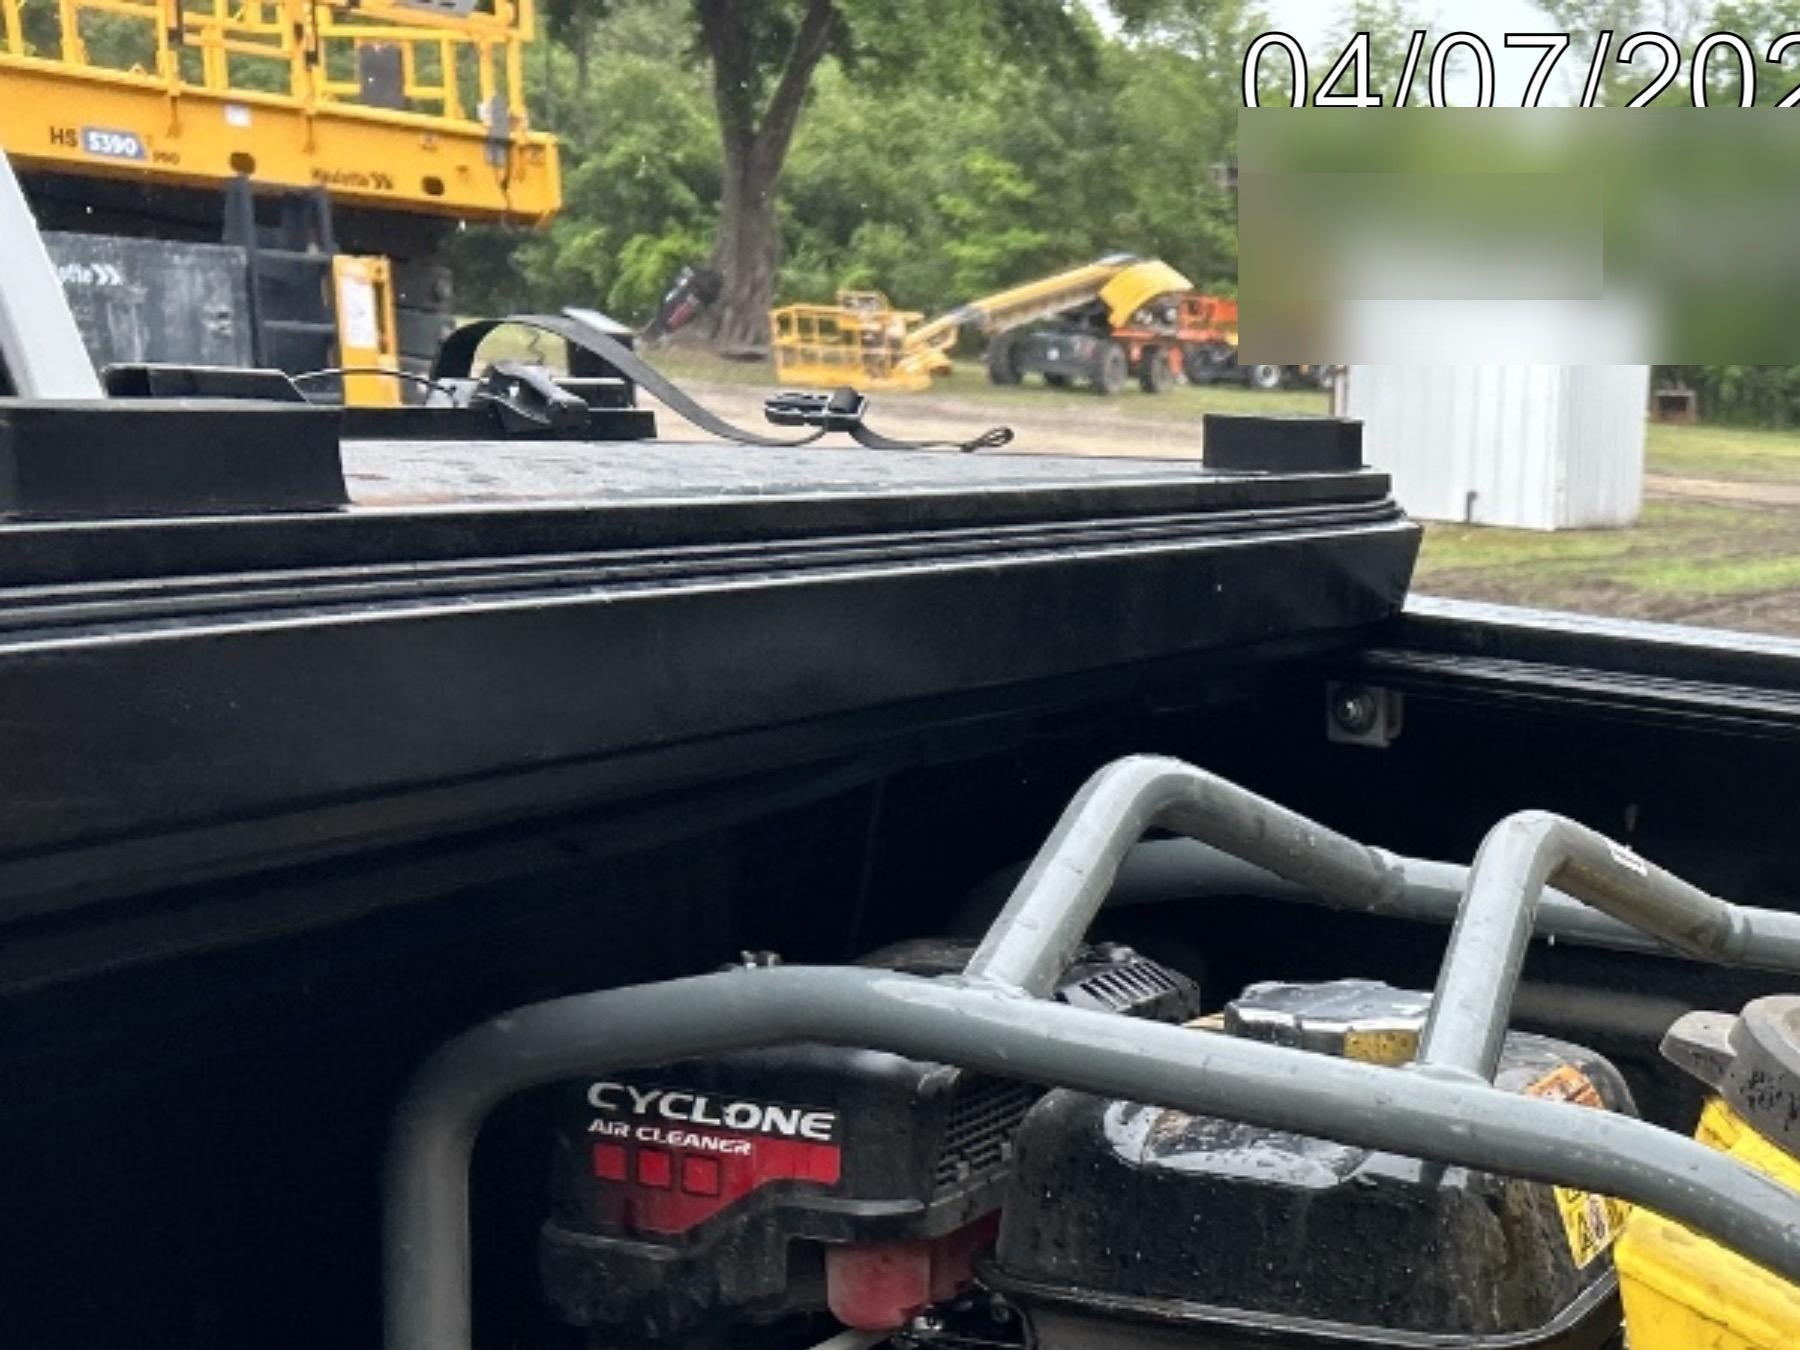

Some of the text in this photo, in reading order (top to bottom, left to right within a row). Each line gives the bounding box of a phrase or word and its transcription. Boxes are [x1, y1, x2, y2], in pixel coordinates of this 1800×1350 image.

[49, 125, 79, 148] HS
[87, 130, 138, 157] 5390
[587, 1081, 837, 1141] CYCLONE
[588, 1118, 751, 1156] AIR CLEANER
